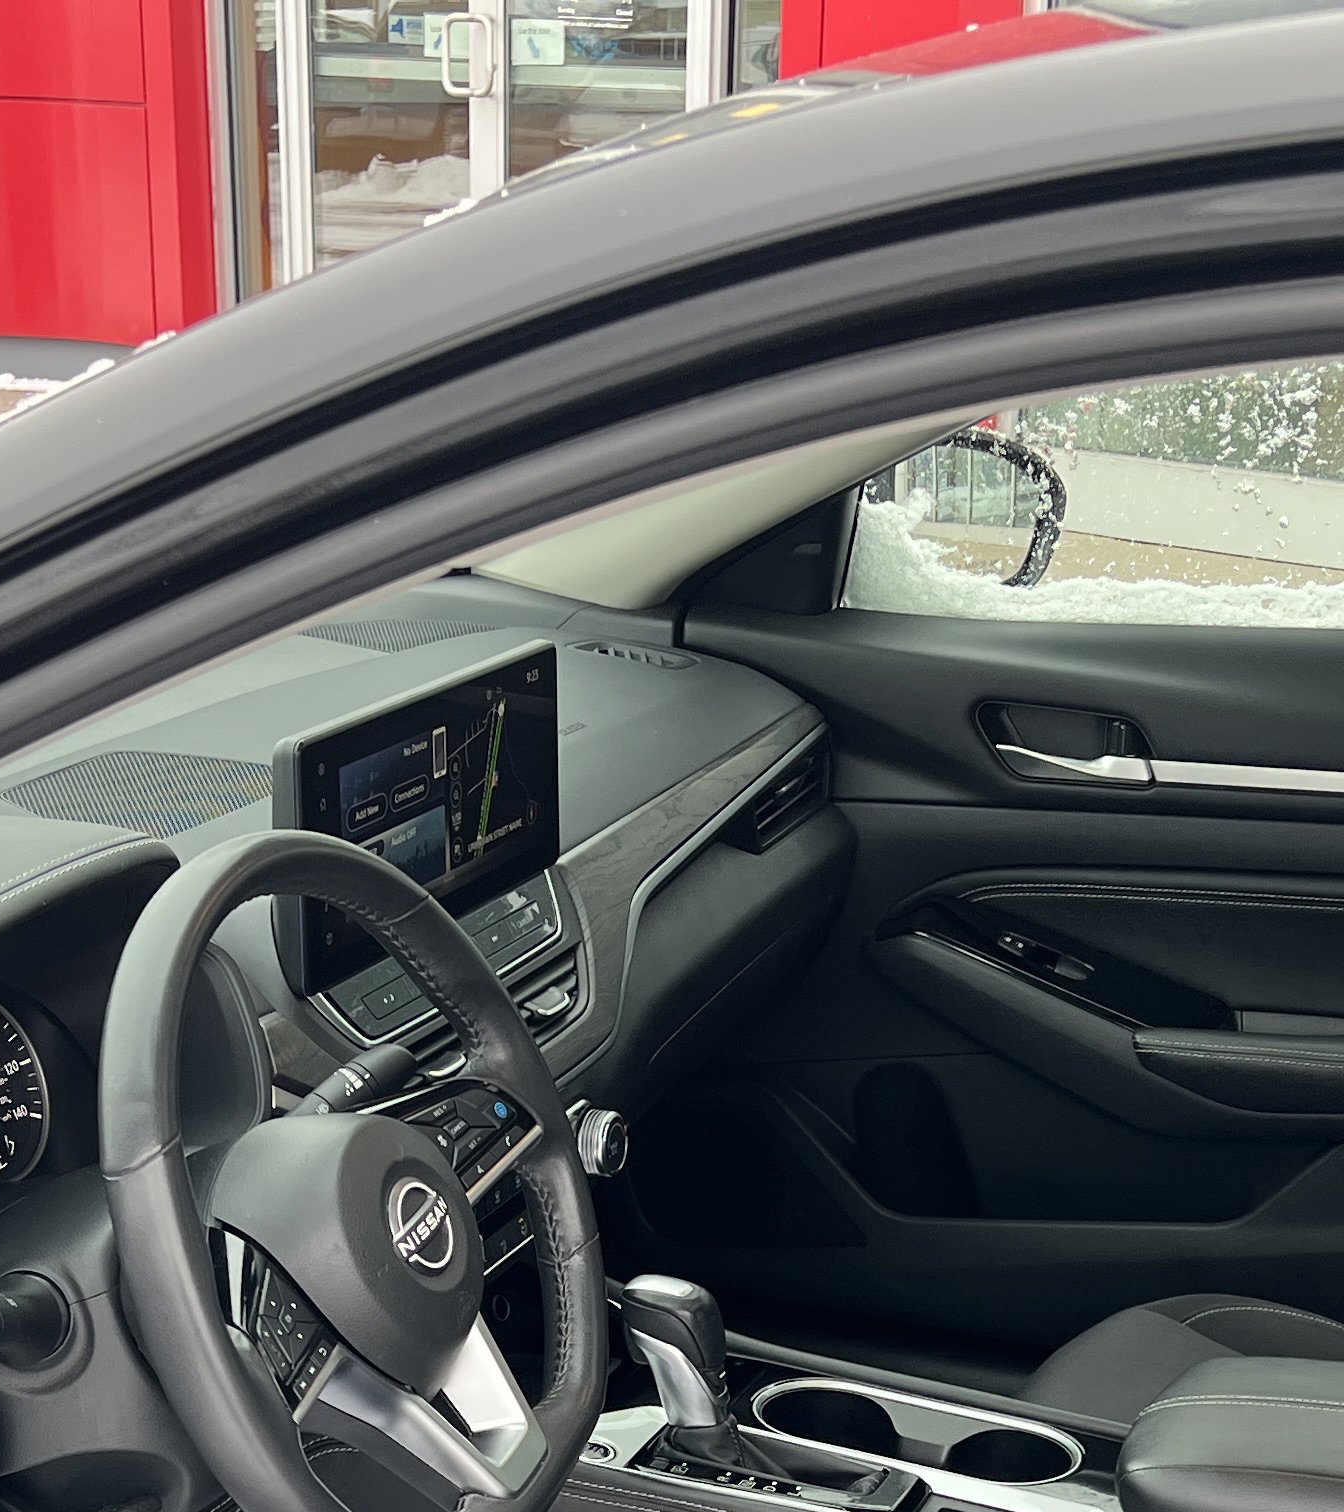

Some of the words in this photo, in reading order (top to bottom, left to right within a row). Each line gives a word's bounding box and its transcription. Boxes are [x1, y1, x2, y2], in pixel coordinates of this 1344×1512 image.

[355, 808, 367, 822] Add
[3, 1060, 20, 1076] 120
[12, 1104, 28, 1121] 140
[397, 1195, 448, 1258] NISSAN
